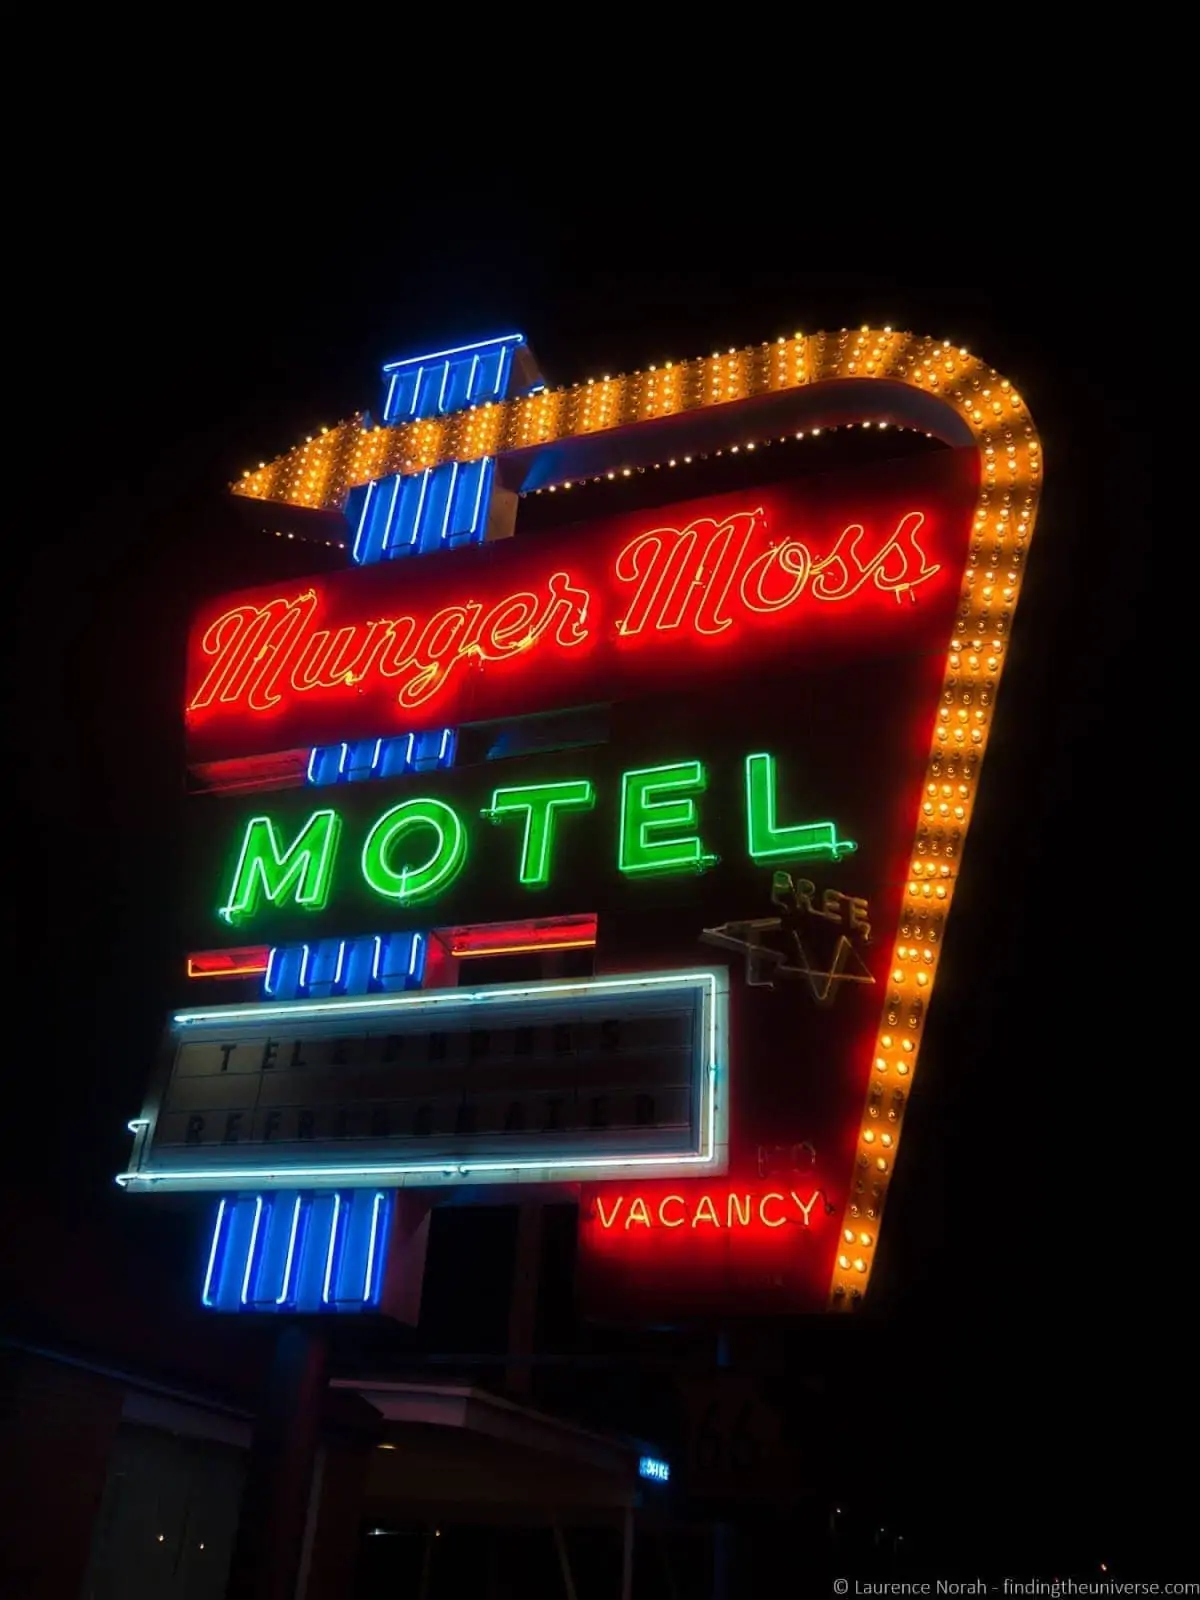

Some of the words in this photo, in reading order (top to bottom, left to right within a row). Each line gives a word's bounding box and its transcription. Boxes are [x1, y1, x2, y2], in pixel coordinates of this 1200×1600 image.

[184, 571, 589, 709] Munger
[614, 505, 941, 636] Moss
[219, 752, 857, 925] MOTEL
[770, 870, 871, 942] FREE
[596, 1190, 820, 1230] VACANCY
